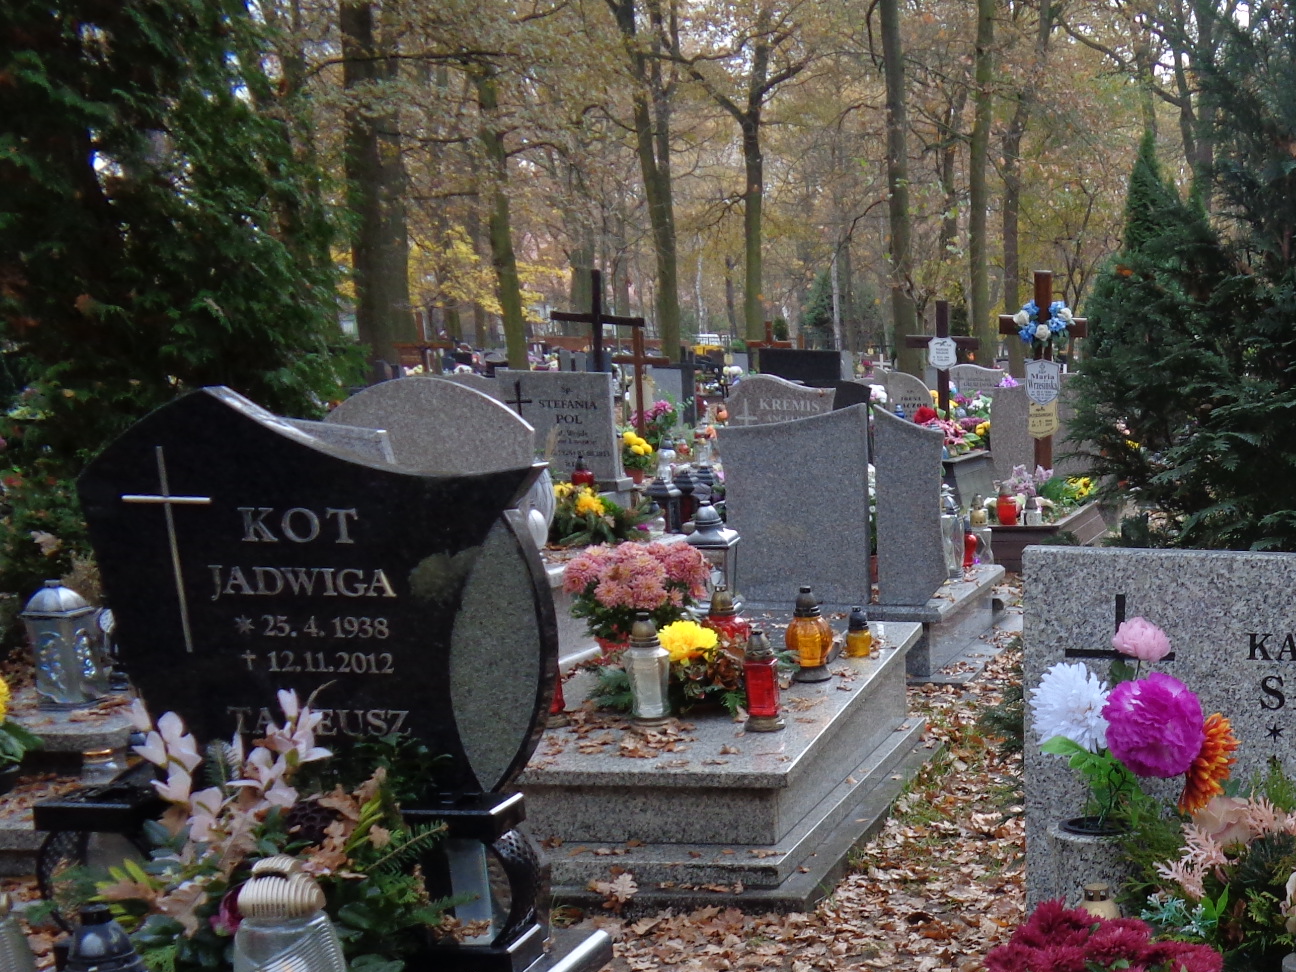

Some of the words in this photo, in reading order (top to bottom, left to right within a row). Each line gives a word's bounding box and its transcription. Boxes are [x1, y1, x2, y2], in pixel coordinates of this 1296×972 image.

[538, 399, 598, 410] STEFANIA
[759, 399, 820, 412] KREMIS
[555, 413, 583, 425] POL
[236, 506, 360, 545] KOT
[207, 564, 398, 601] JADWIGA
[267, 651, 395, 674] 12.11.2012
[227, 706, 413, 736] TAEUSZ
